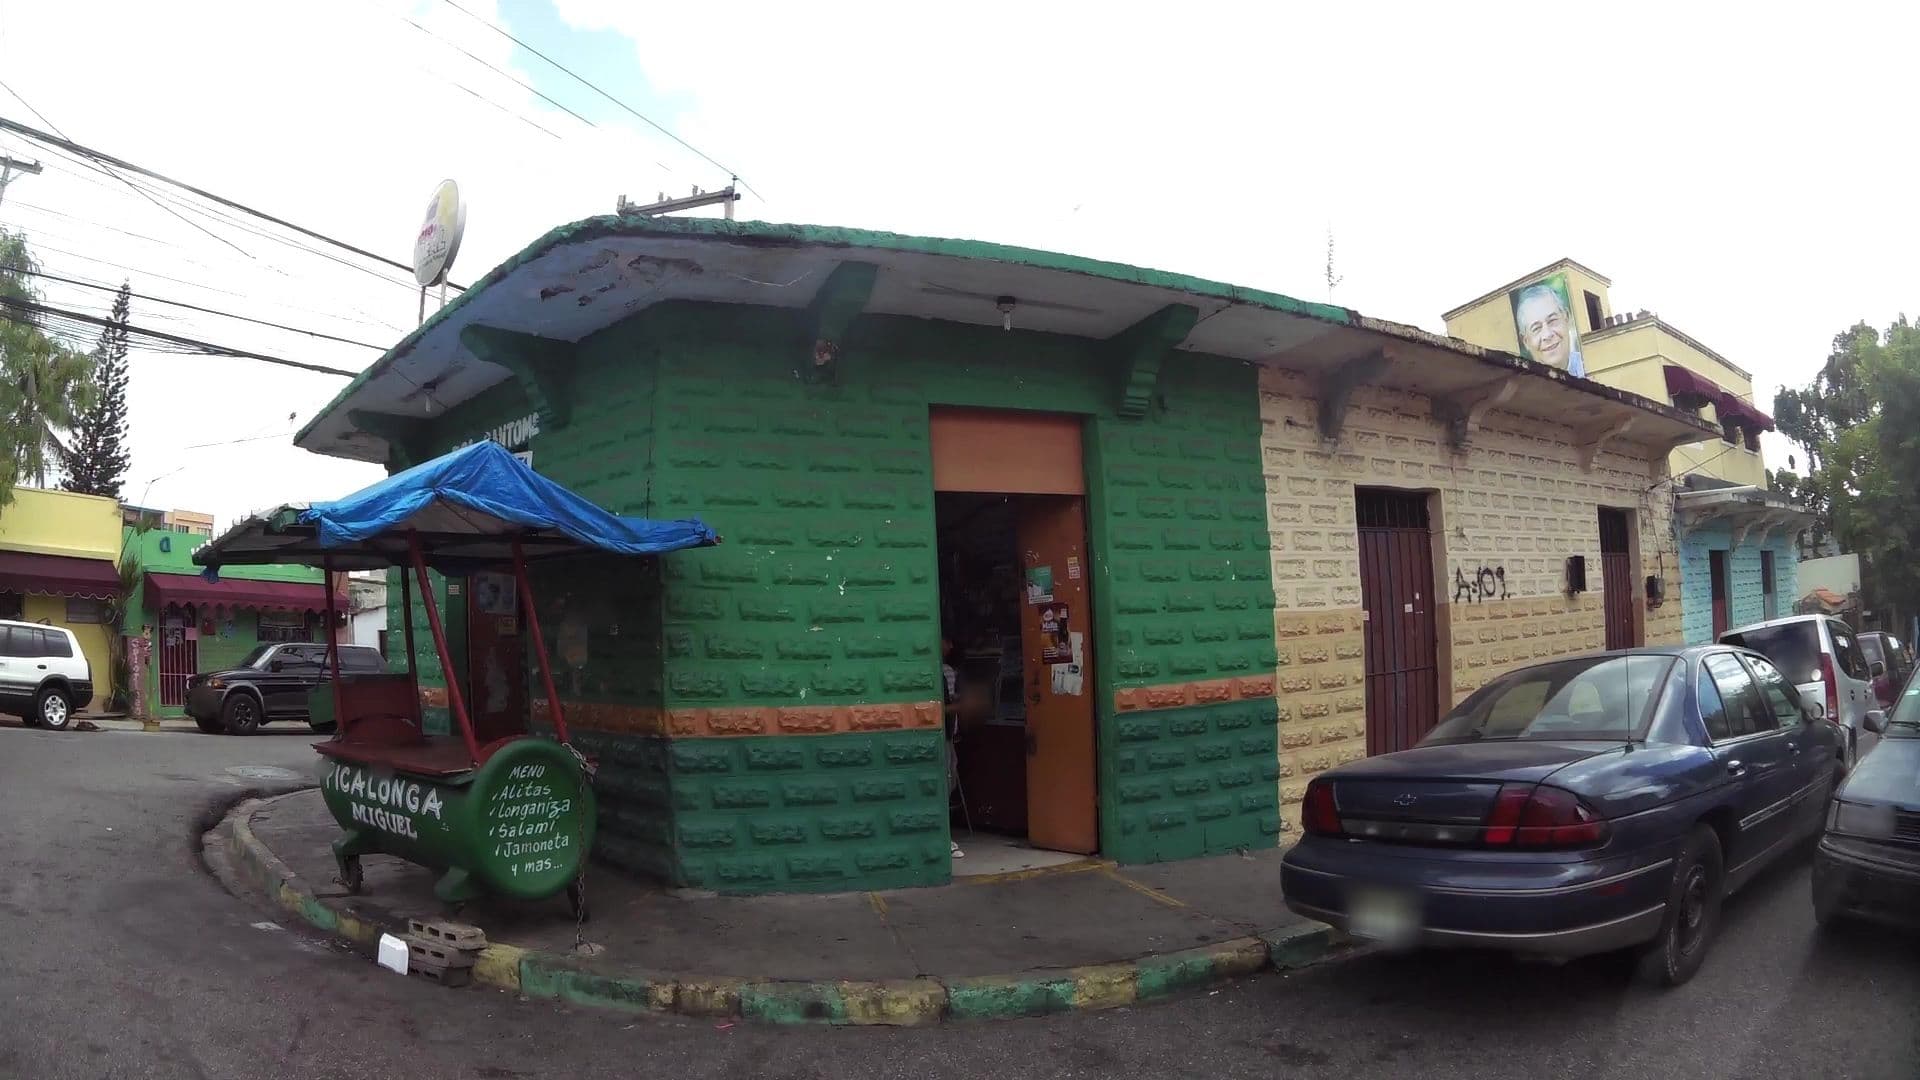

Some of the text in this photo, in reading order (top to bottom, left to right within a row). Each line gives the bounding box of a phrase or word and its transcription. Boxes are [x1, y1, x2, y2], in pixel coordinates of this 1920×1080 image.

[508, 765, 545, 779] MENU
[351, 801, 418, 839] MIGUEL
[503, 832, 569, 857] Jamoneta
